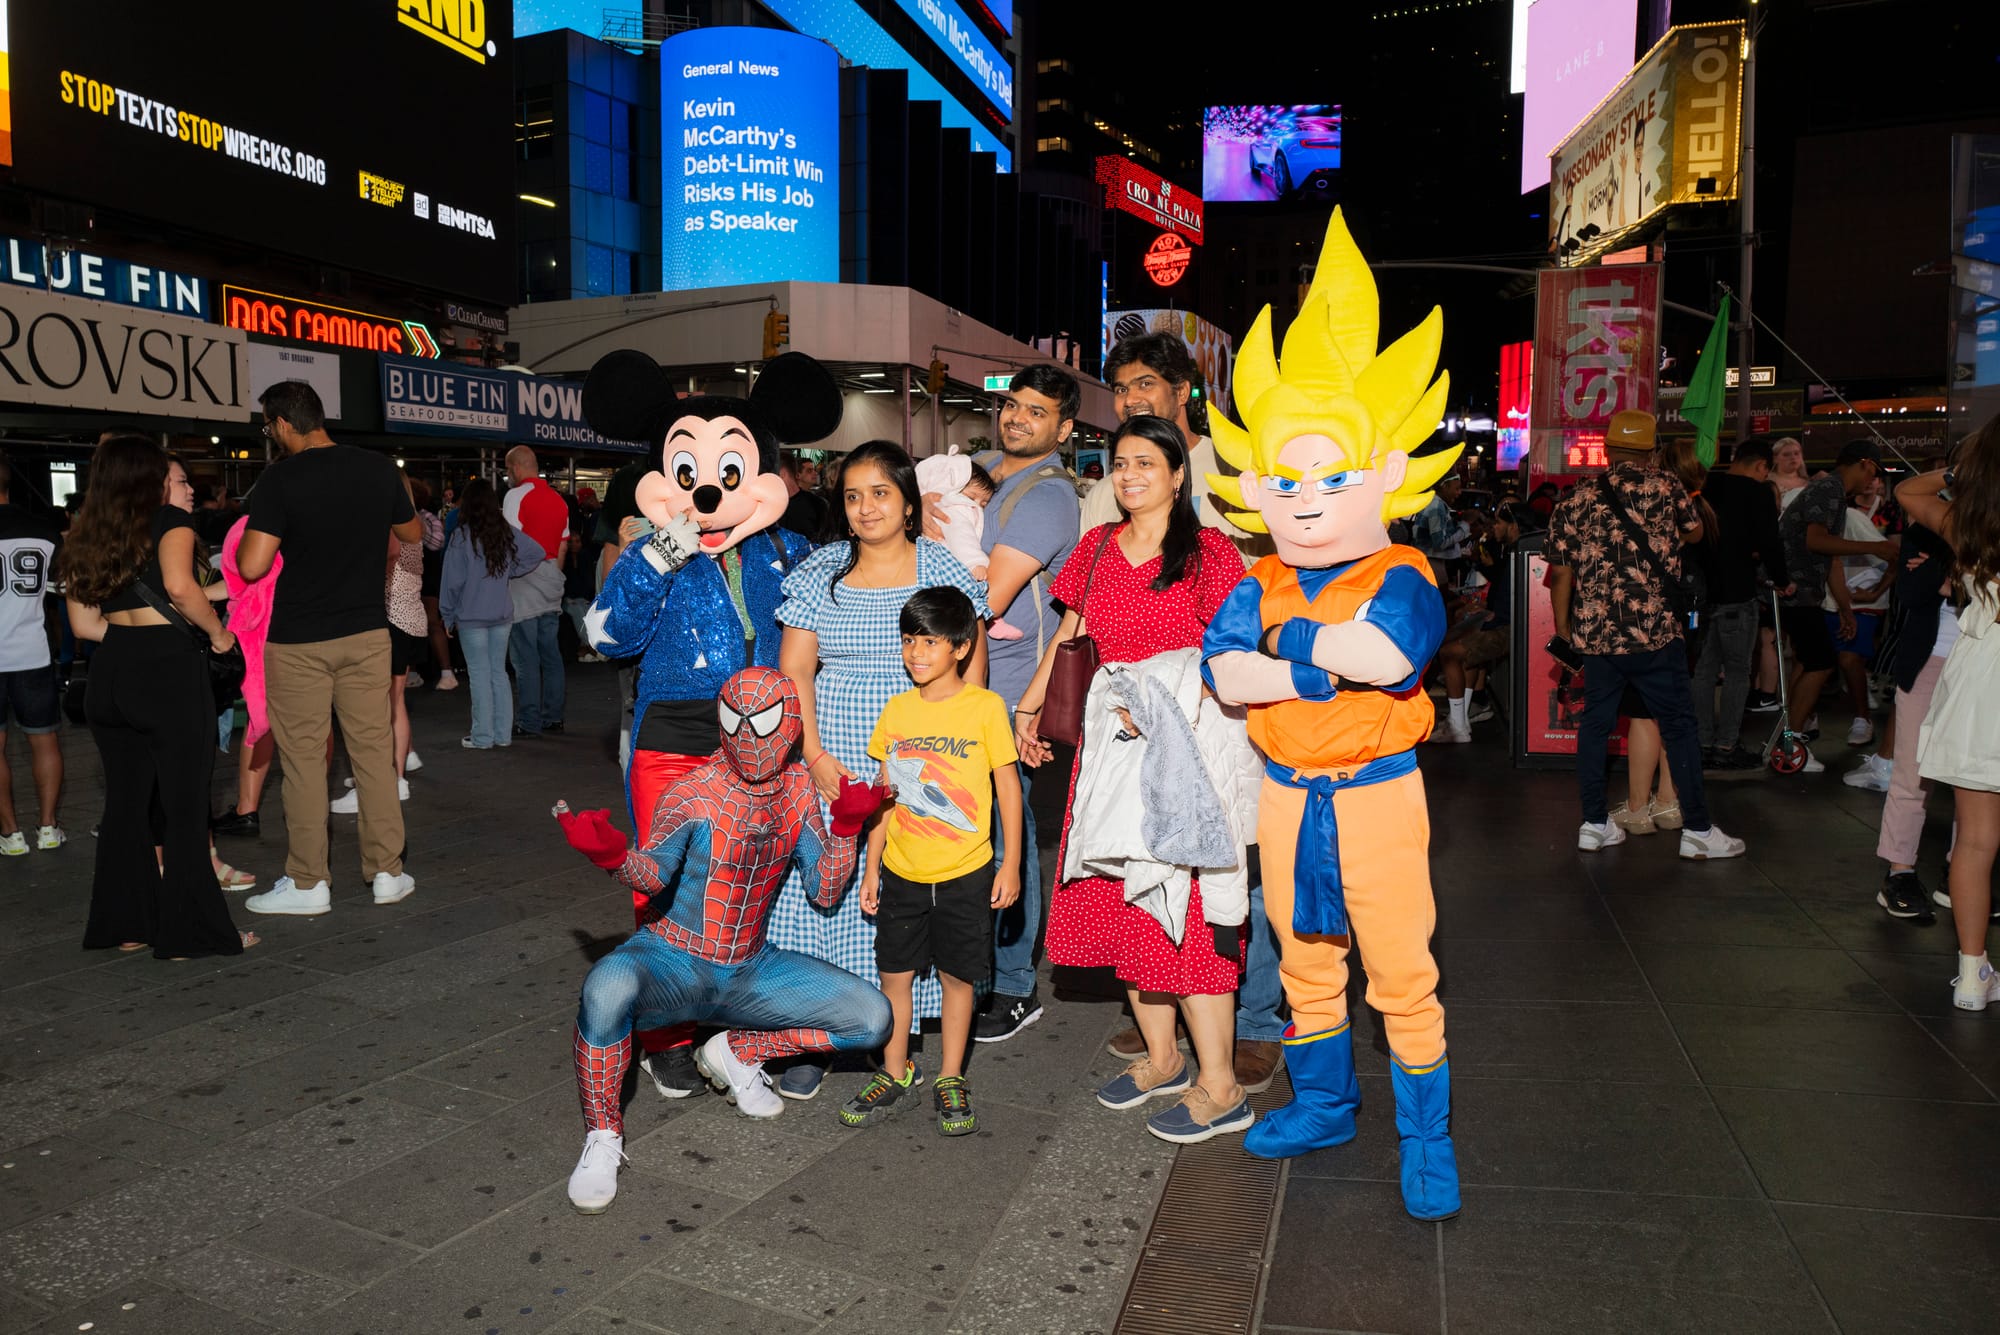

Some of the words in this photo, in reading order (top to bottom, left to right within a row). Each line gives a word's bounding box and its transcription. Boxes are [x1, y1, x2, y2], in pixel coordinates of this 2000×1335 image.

[683, 60, 733, 78] General
[738, 60, 780, 77] News
[949, 14, 997, 91] McCarthy's
[1555, 48, 1590, 81] LANE
[683, 97, 735, 120] Kevin
[1687, 35, 1728, 193] HELLO!
[60, 70, 326, 186] STOPTEXTSSTOPWRECKS.ORG
[684, 125, 796, 150] McCarthy's
[1562, 122, 1618, 197] MISSIONARY
[1620, 89, 1656, 146] STYLE
[684, 153, 789, 176] Debt-Limit
[794, 158, 823, 183] Win
[684, 182, 735, 204] Risks
[741, 182, 777, 203] His
[782, 185, 814, 208] Job
[450, 207, 496, 240] NHTSA
[684, 215, 704, 232] as
[710, 210, 798, 233] Speaker
[1173, 203, 1200, 228] PLAZA
[1157, 237, 1178, 250] HOT
[0, 238, 105, 297] LUE
[130, 264, 200, 314] FIN
[1155, 268, 1179, 281] NOW
[295, 308, 402, 354] CAMINOS
[1563, 279, 1639, 420] tkts
[390, 369, 455, 405] BLUE
[467, 381, 505, 410] FIN
[518, 380, 582, 421] NOW
[390, 406, 455, 421] SEAFOOD
[469, 413, 506, 427] SUSHI
[535, 423, 557, 440] FOR
[560, 425, 594, 443] LUNCH
[0, 547, 47, 597] 9
